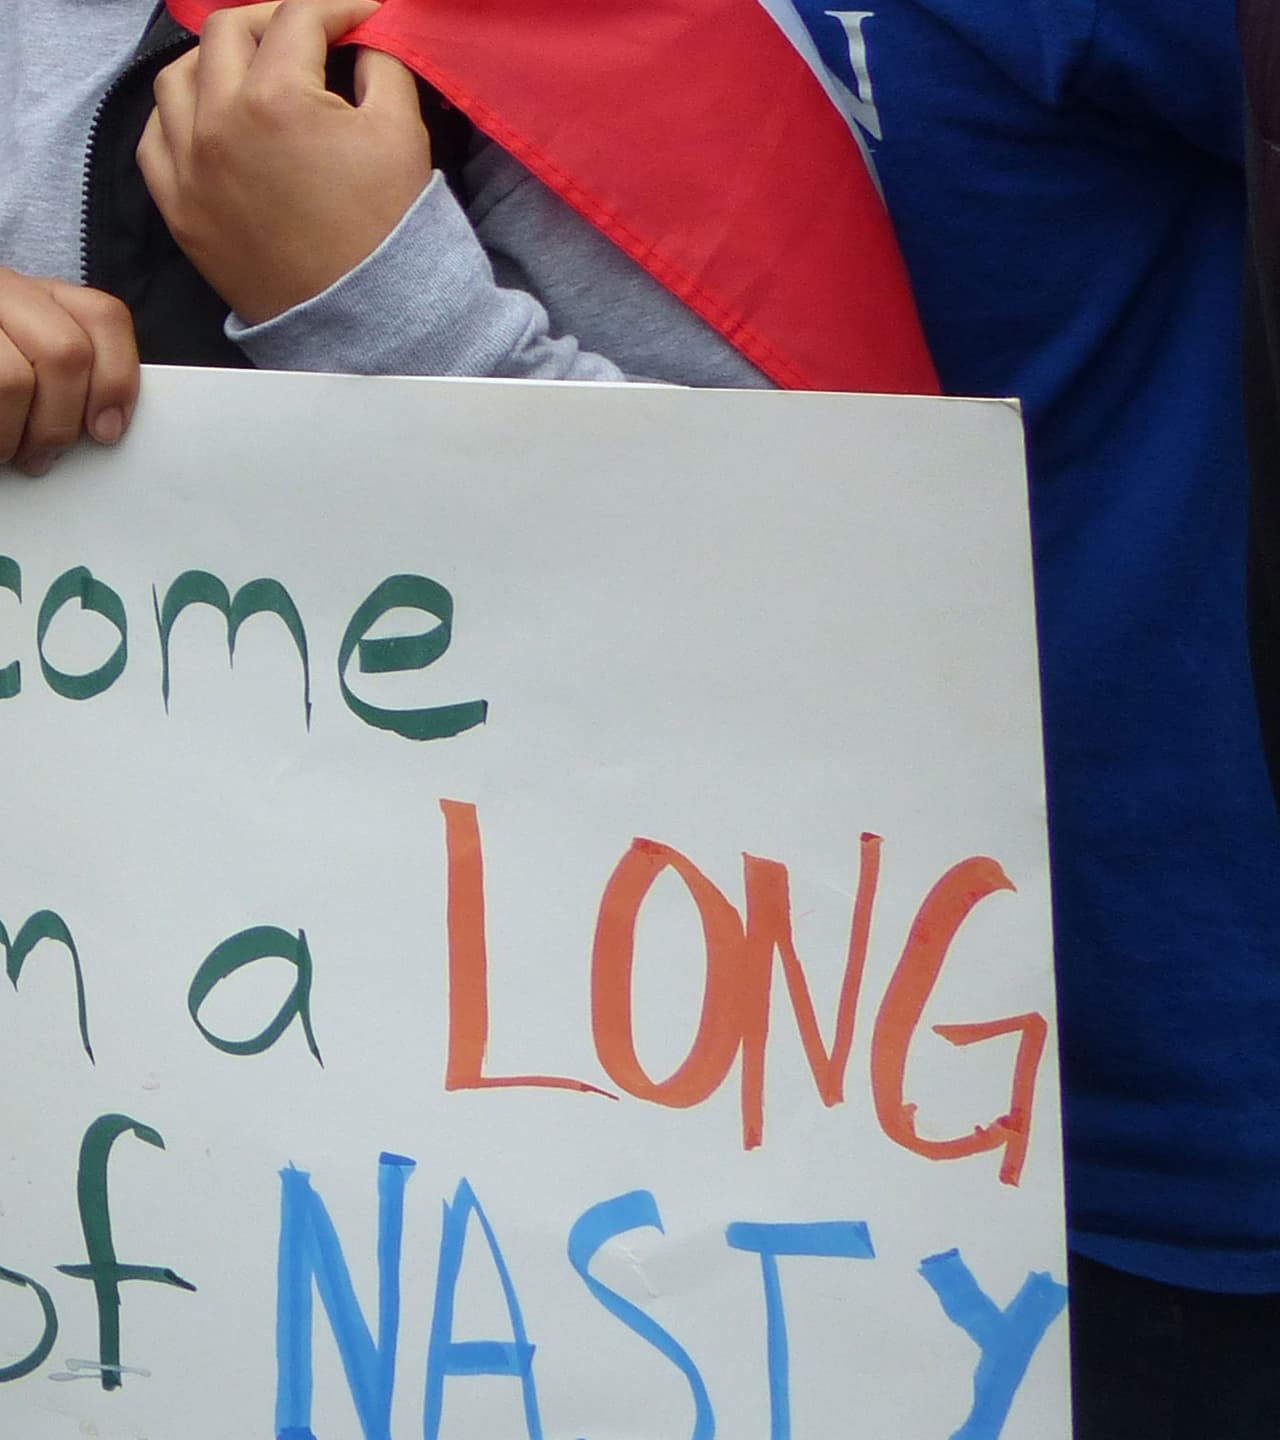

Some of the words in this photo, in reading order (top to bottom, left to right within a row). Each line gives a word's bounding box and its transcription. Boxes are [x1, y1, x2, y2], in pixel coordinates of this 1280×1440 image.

[187, 924, 325, 1069] a
[438, 797, 1048, 1188] LONG
[272, 1151, 1070, 1440] NASTY
